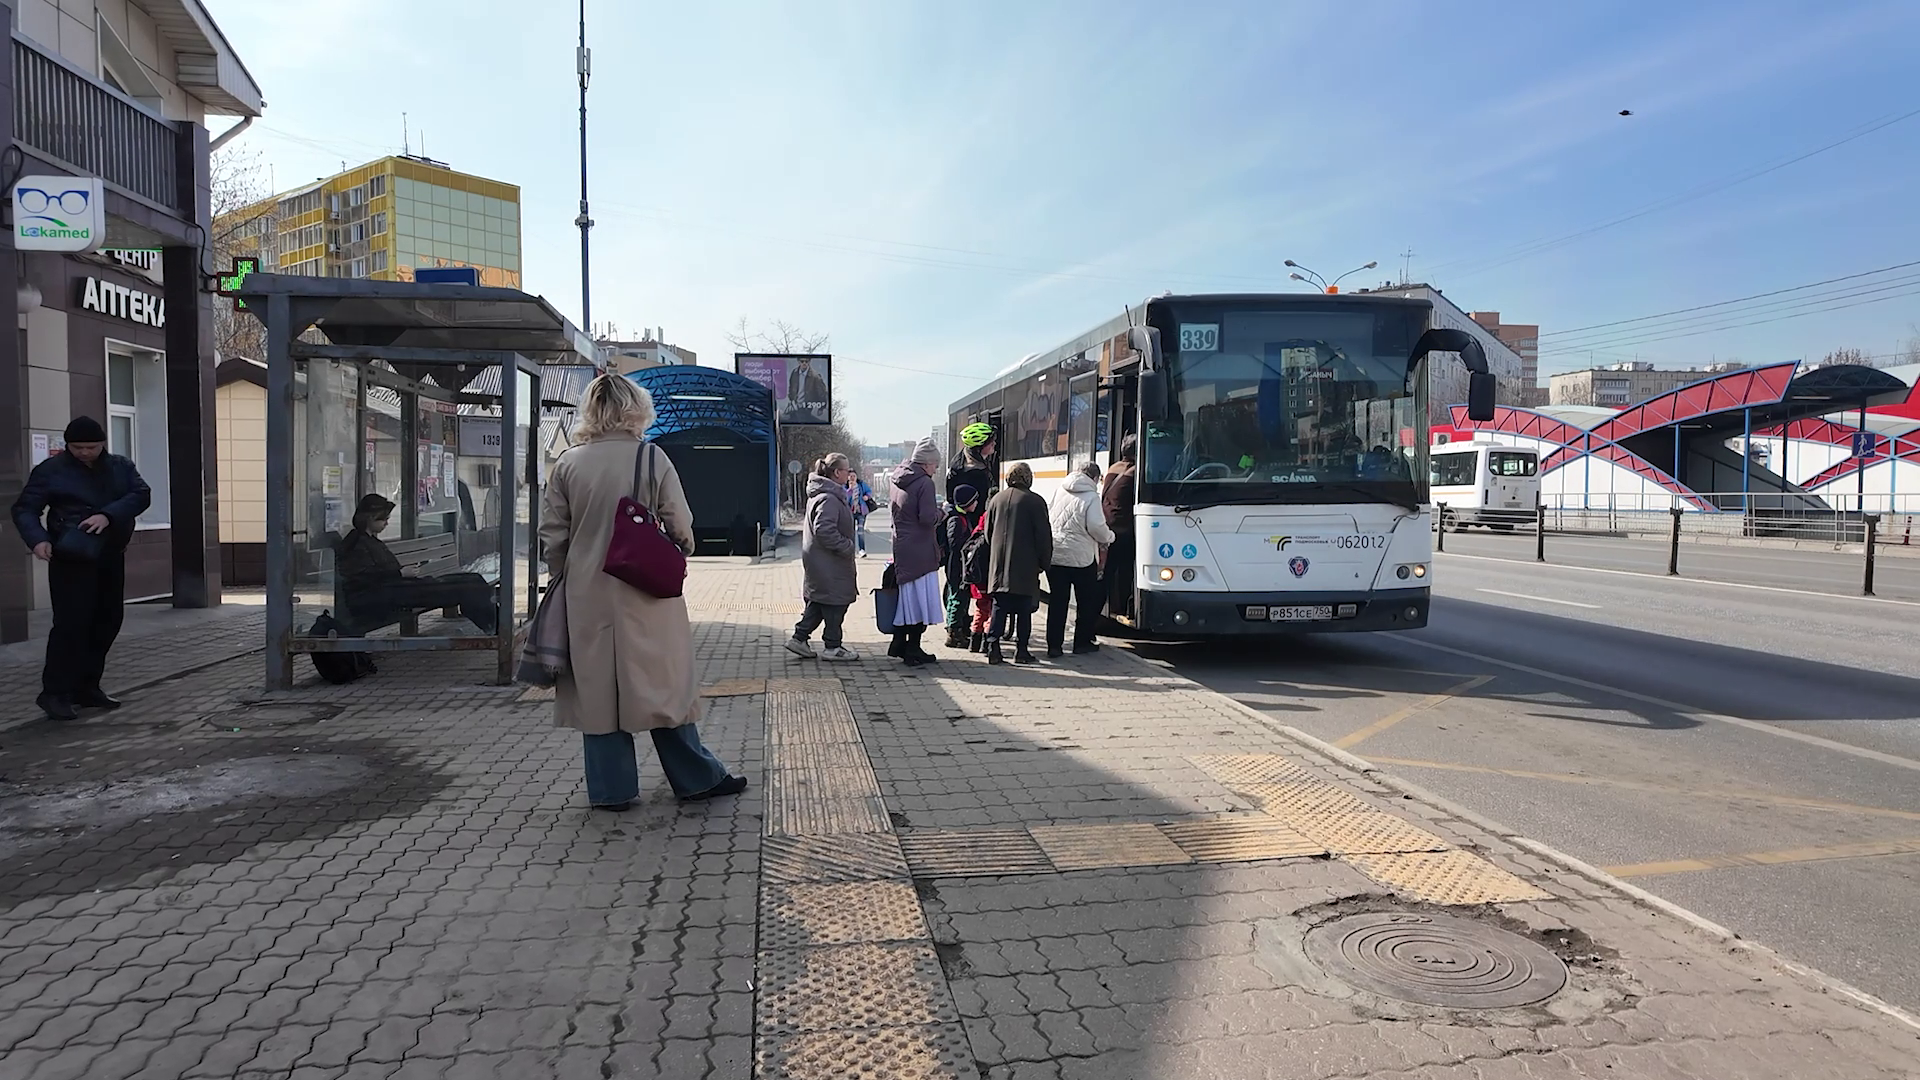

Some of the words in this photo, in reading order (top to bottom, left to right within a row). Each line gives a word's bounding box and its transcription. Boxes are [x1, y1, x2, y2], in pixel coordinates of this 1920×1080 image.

[20, 225, 90, 239] Lokamed
[1181, 329, 1216, 350] 339
[1271, 471, 1318, 483] SCANIA
